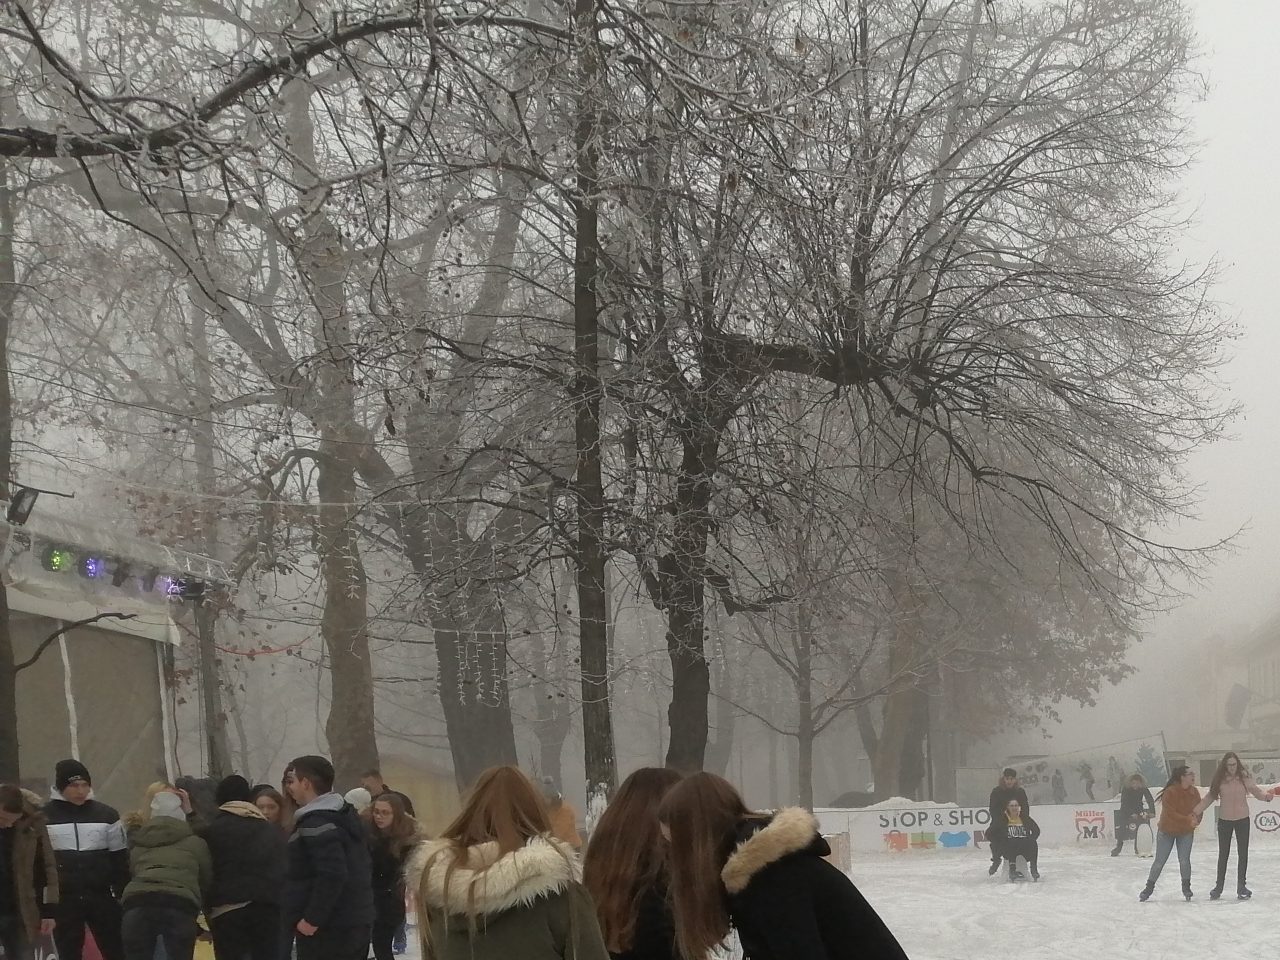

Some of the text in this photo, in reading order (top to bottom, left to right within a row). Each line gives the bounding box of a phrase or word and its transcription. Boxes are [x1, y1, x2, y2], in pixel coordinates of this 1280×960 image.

[933, 813, 944, 826] &
[949, 809, 991, 826] SHO
[1075, 810, 1105, 818] Müller
